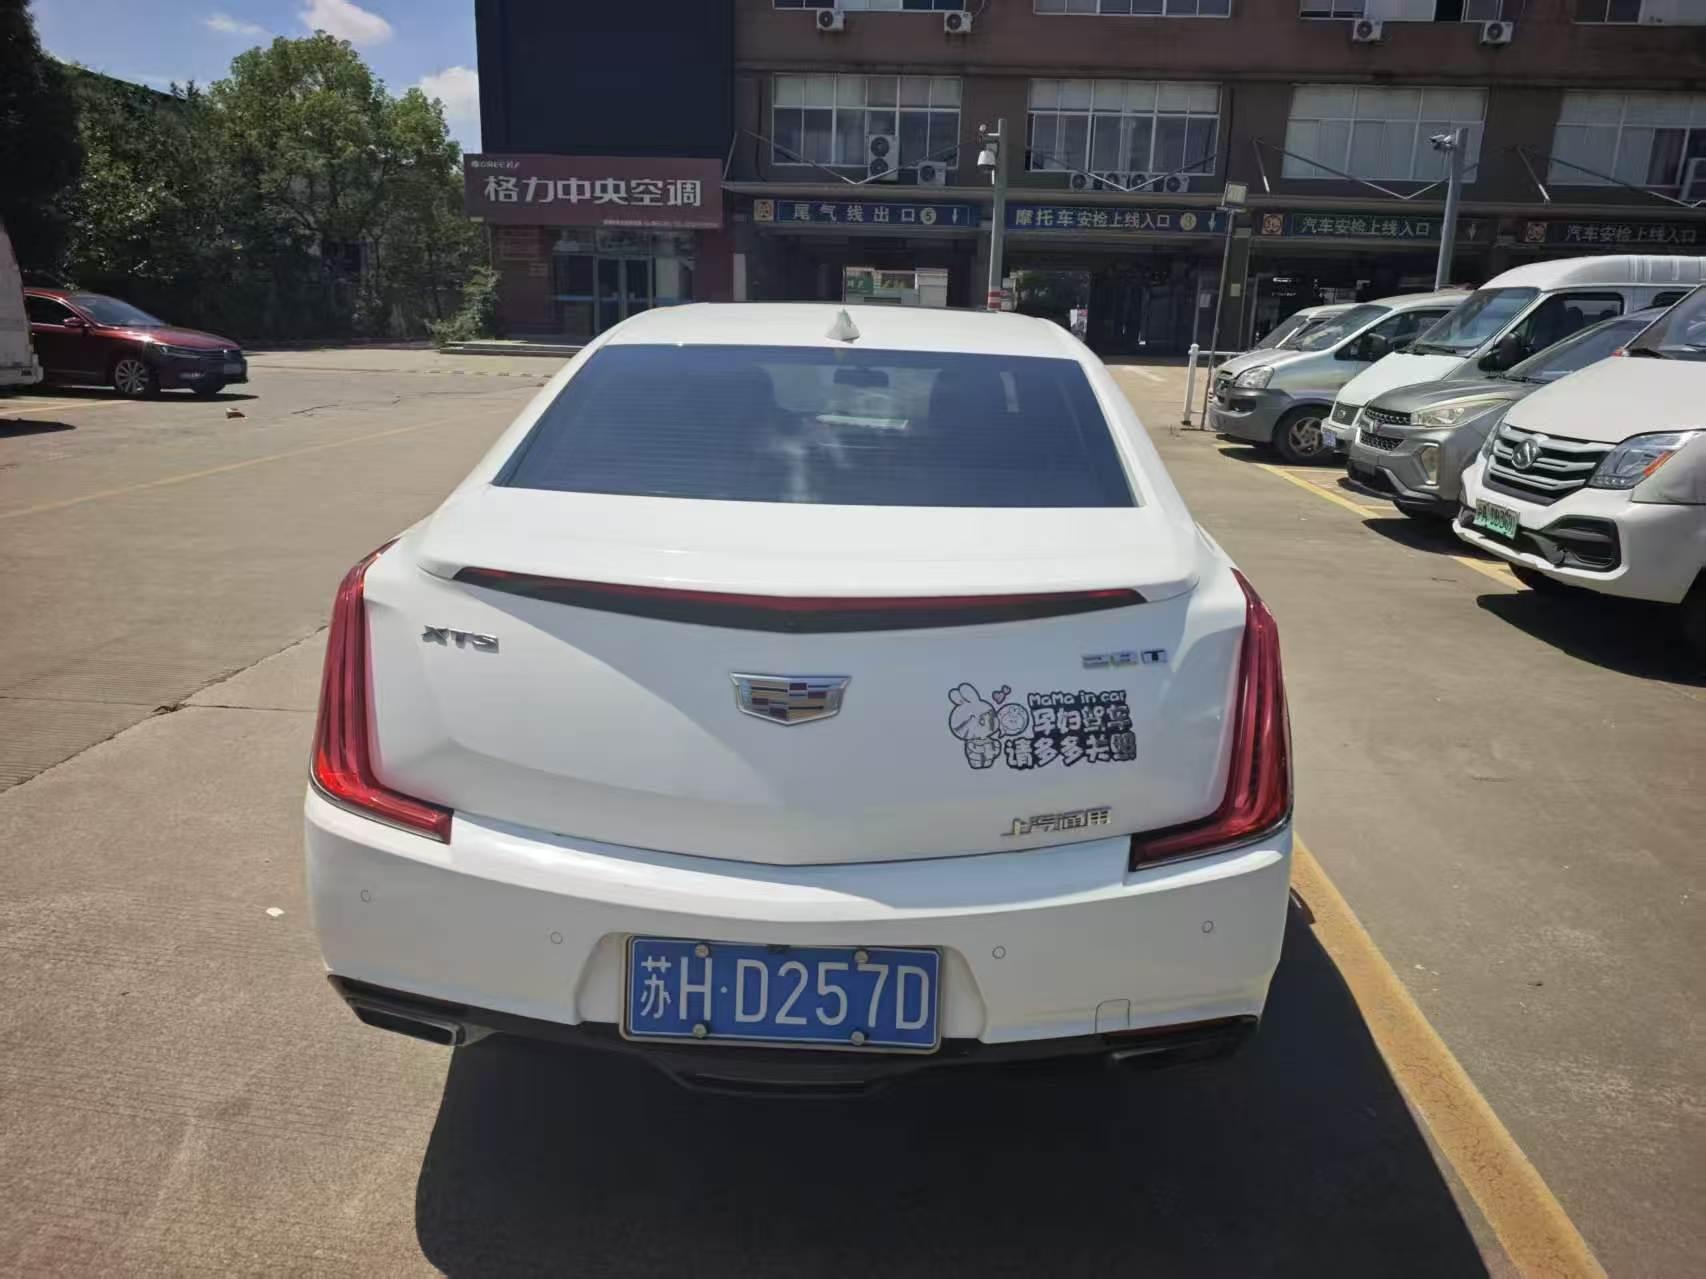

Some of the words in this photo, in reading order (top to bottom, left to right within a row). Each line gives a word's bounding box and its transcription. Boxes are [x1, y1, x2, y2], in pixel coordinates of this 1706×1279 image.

[484, 176, 701, 207] 格力中央空调
[793, 203, 916, 223] 尾气线出口
[1015, 208, 1171, 230] 摩托车安检上线入口
[1302, 216, 1430, 237] 汽车安检上线入口
[421, 624, 499, 654] XTS
[1080, 691, 1097, 704] in
[641, 956, 929, 1031] 苏H·D257D
